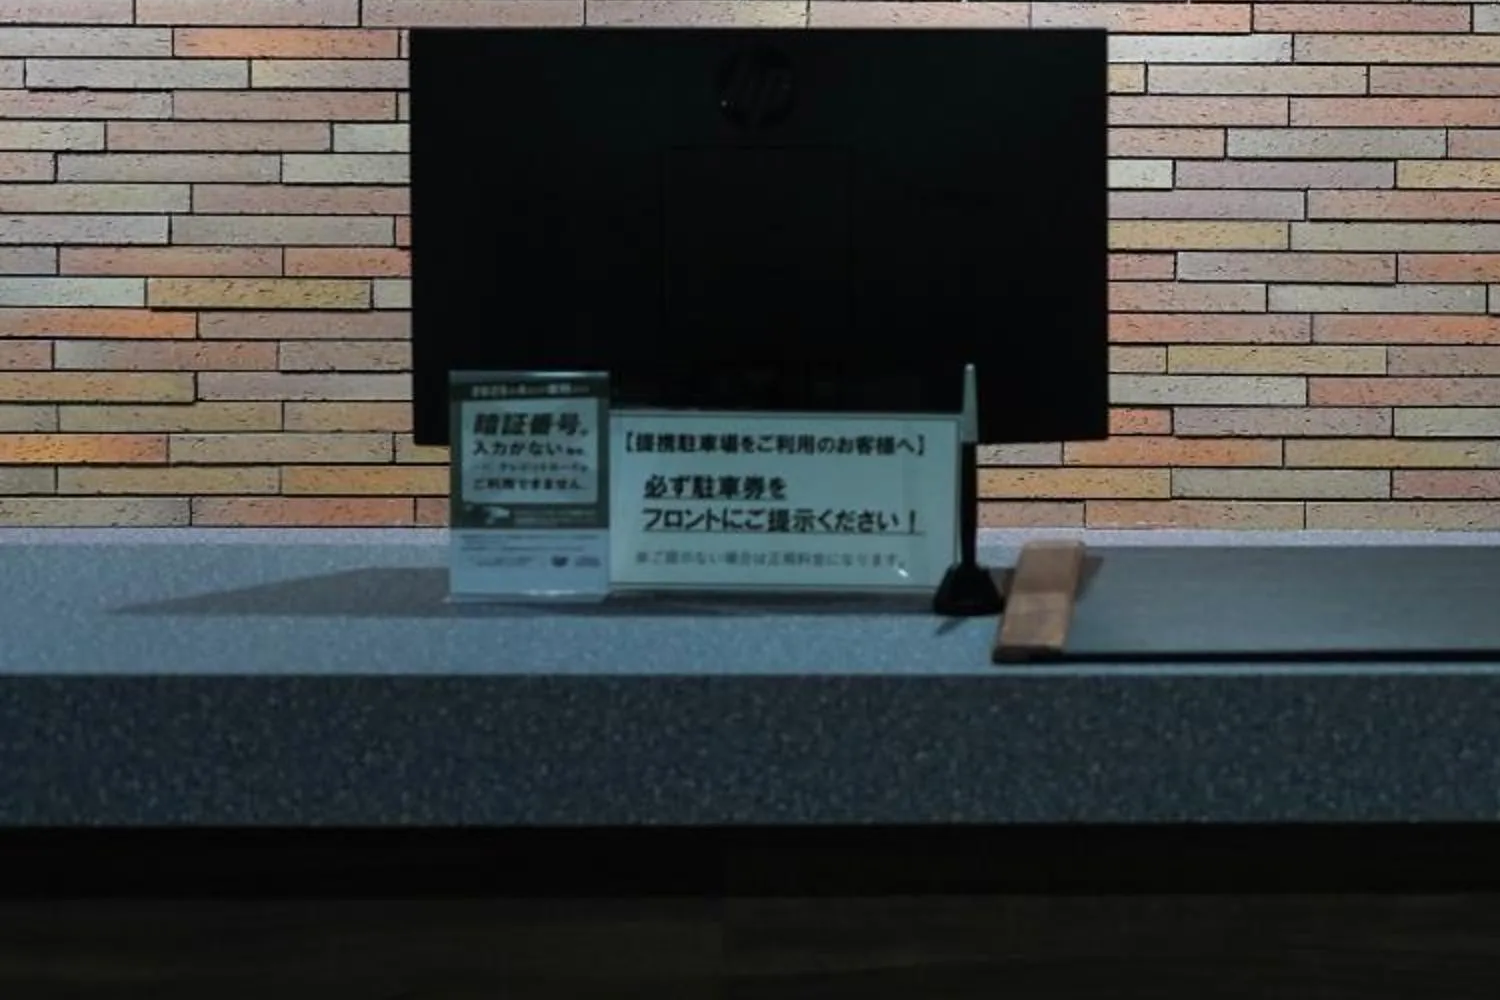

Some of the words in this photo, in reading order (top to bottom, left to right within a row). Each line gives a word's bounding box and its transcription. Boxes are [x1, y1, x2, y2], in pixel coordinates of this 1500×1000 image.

[643, 474, 787, 500] 必ず駐車券を
